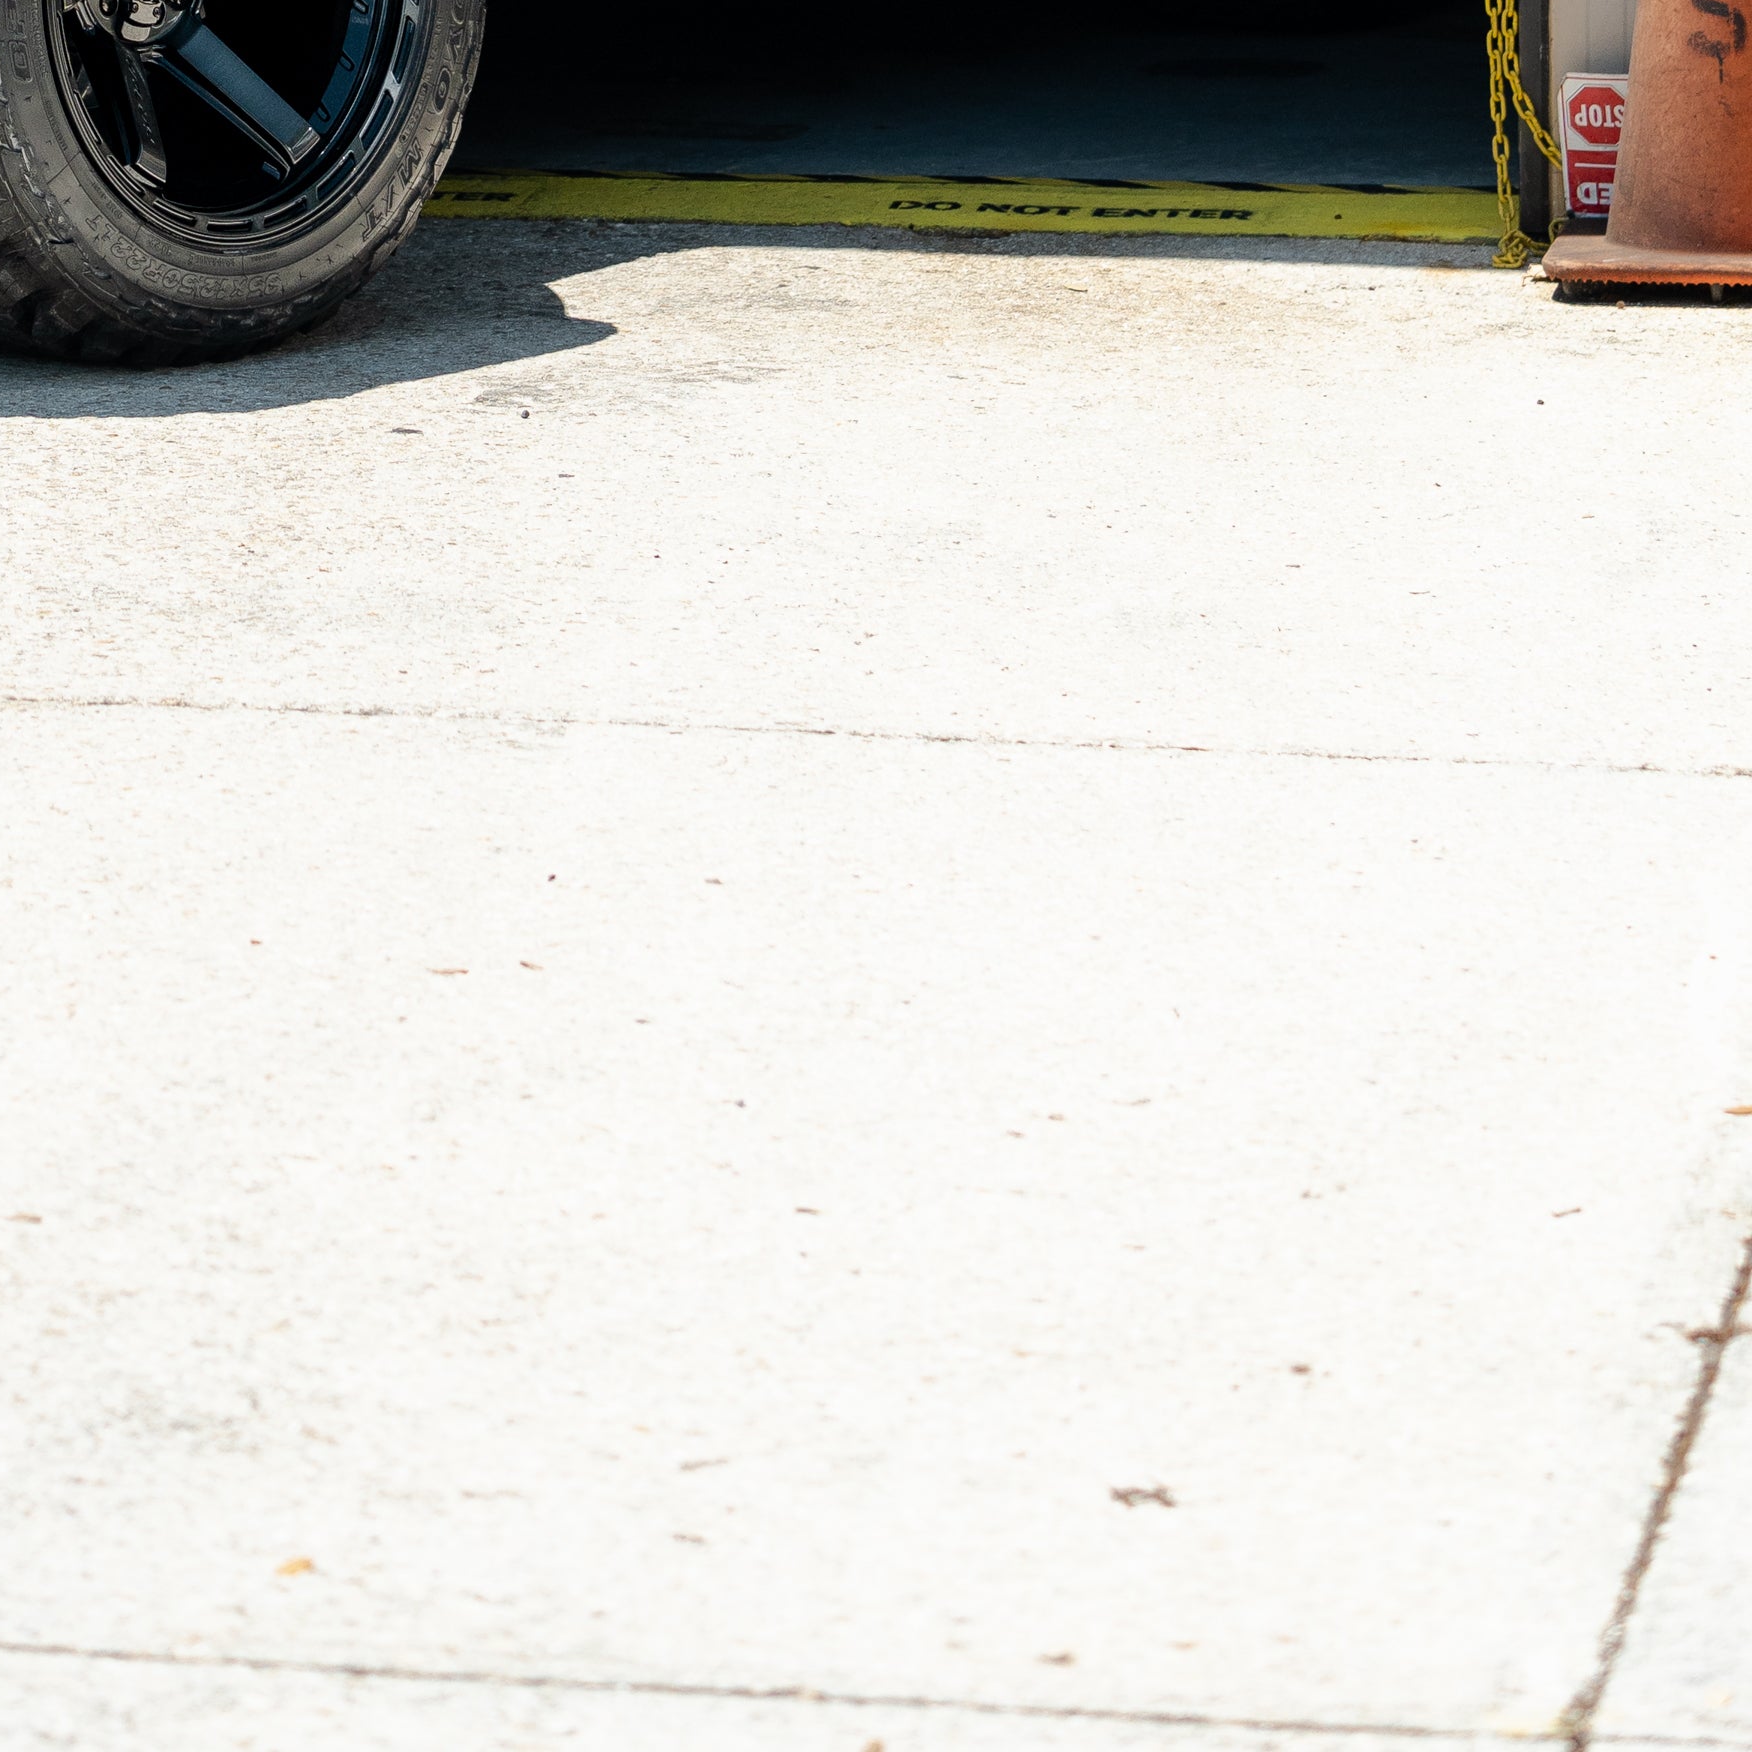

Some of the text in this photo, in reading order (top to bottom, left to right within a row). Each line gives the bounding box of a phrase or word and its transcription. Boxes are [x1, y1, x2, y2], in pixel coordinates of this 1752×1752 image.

[1574, 103, 1625, 128] STOP
[889, 199, 1255, 221] DO NOT ENTER
